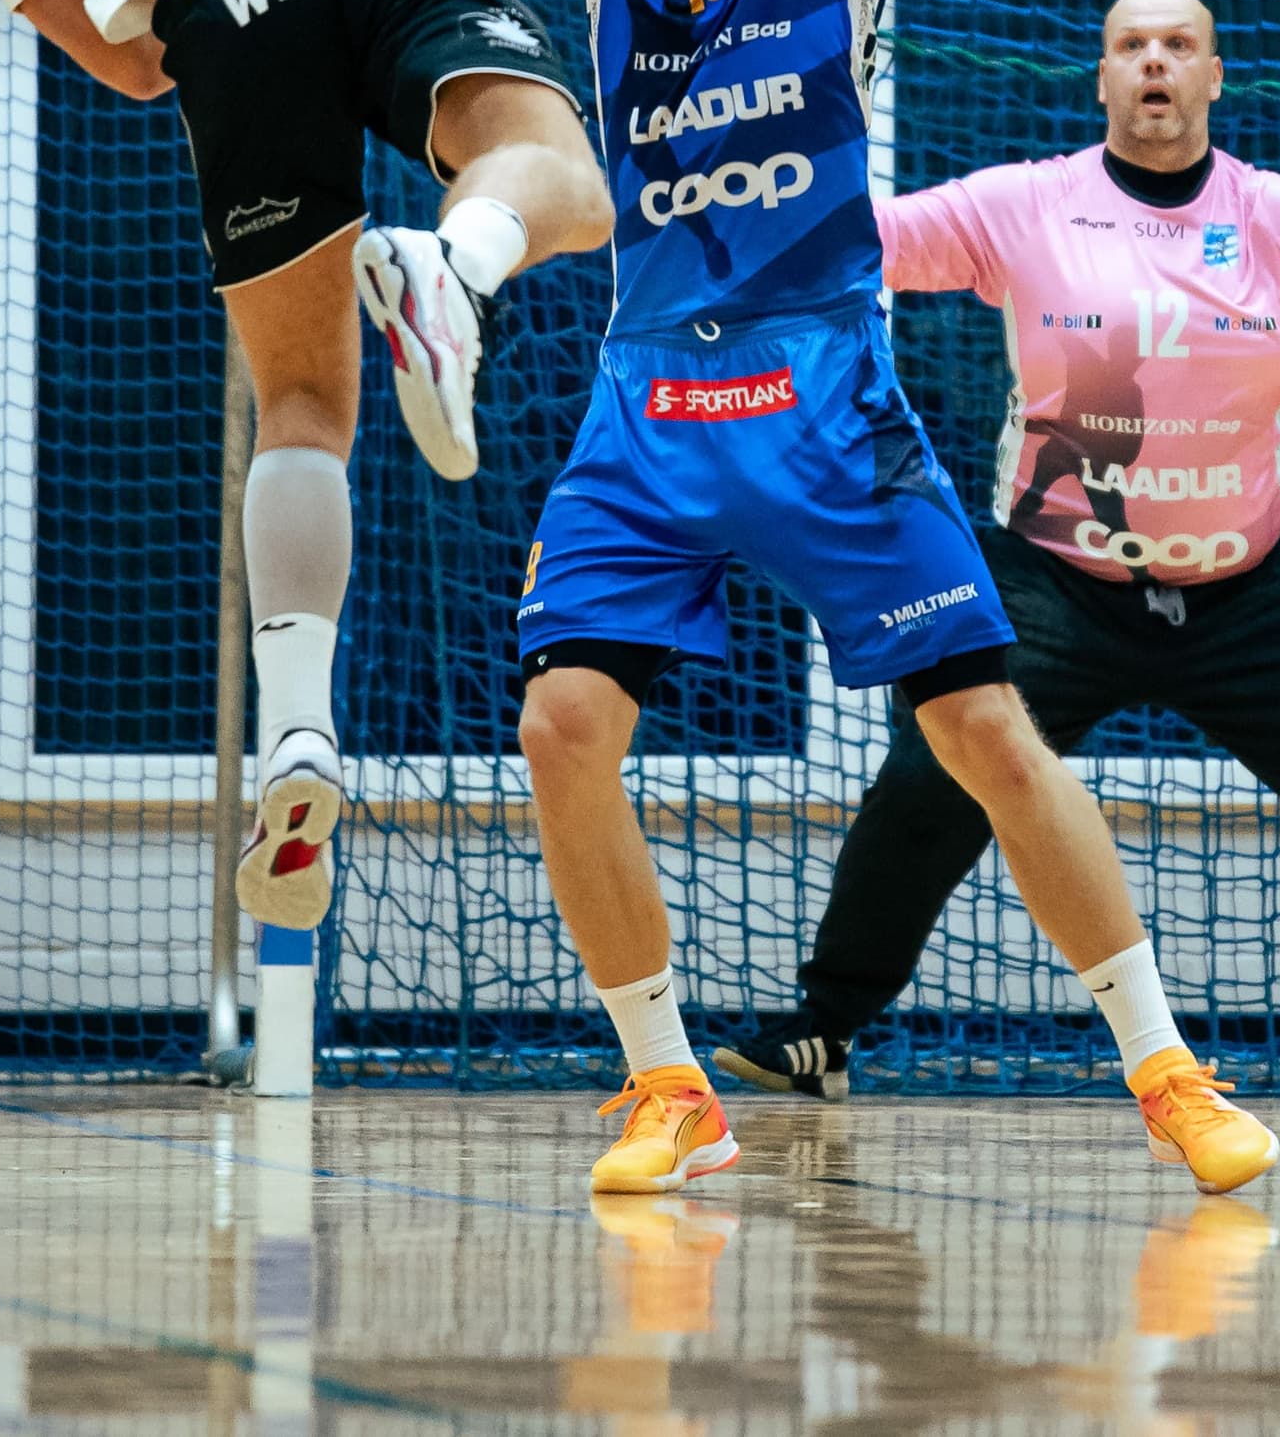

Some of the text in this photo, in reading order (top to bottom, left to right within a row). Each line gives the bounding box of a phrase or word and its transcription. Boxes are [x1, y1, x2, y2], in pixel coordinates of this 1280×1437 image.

[741, 20, 791, 42] Bag
[629, 72, 805, 144] LAADUR
[1134, 222, 1185, 239] SU.VI
[1042, 313, 1082, 329] Mobil
[1130, 290, 1190, 358] 12
[1215, 316, 1262, 331] Mobil
[1080, 414, 1241, 435] HORIZON Bag
[1081, 458, 1243, 501] LAADUR
[893, 582, 979, 624] MULTIMEK
[898, 615, 937, 636] BALTIC
